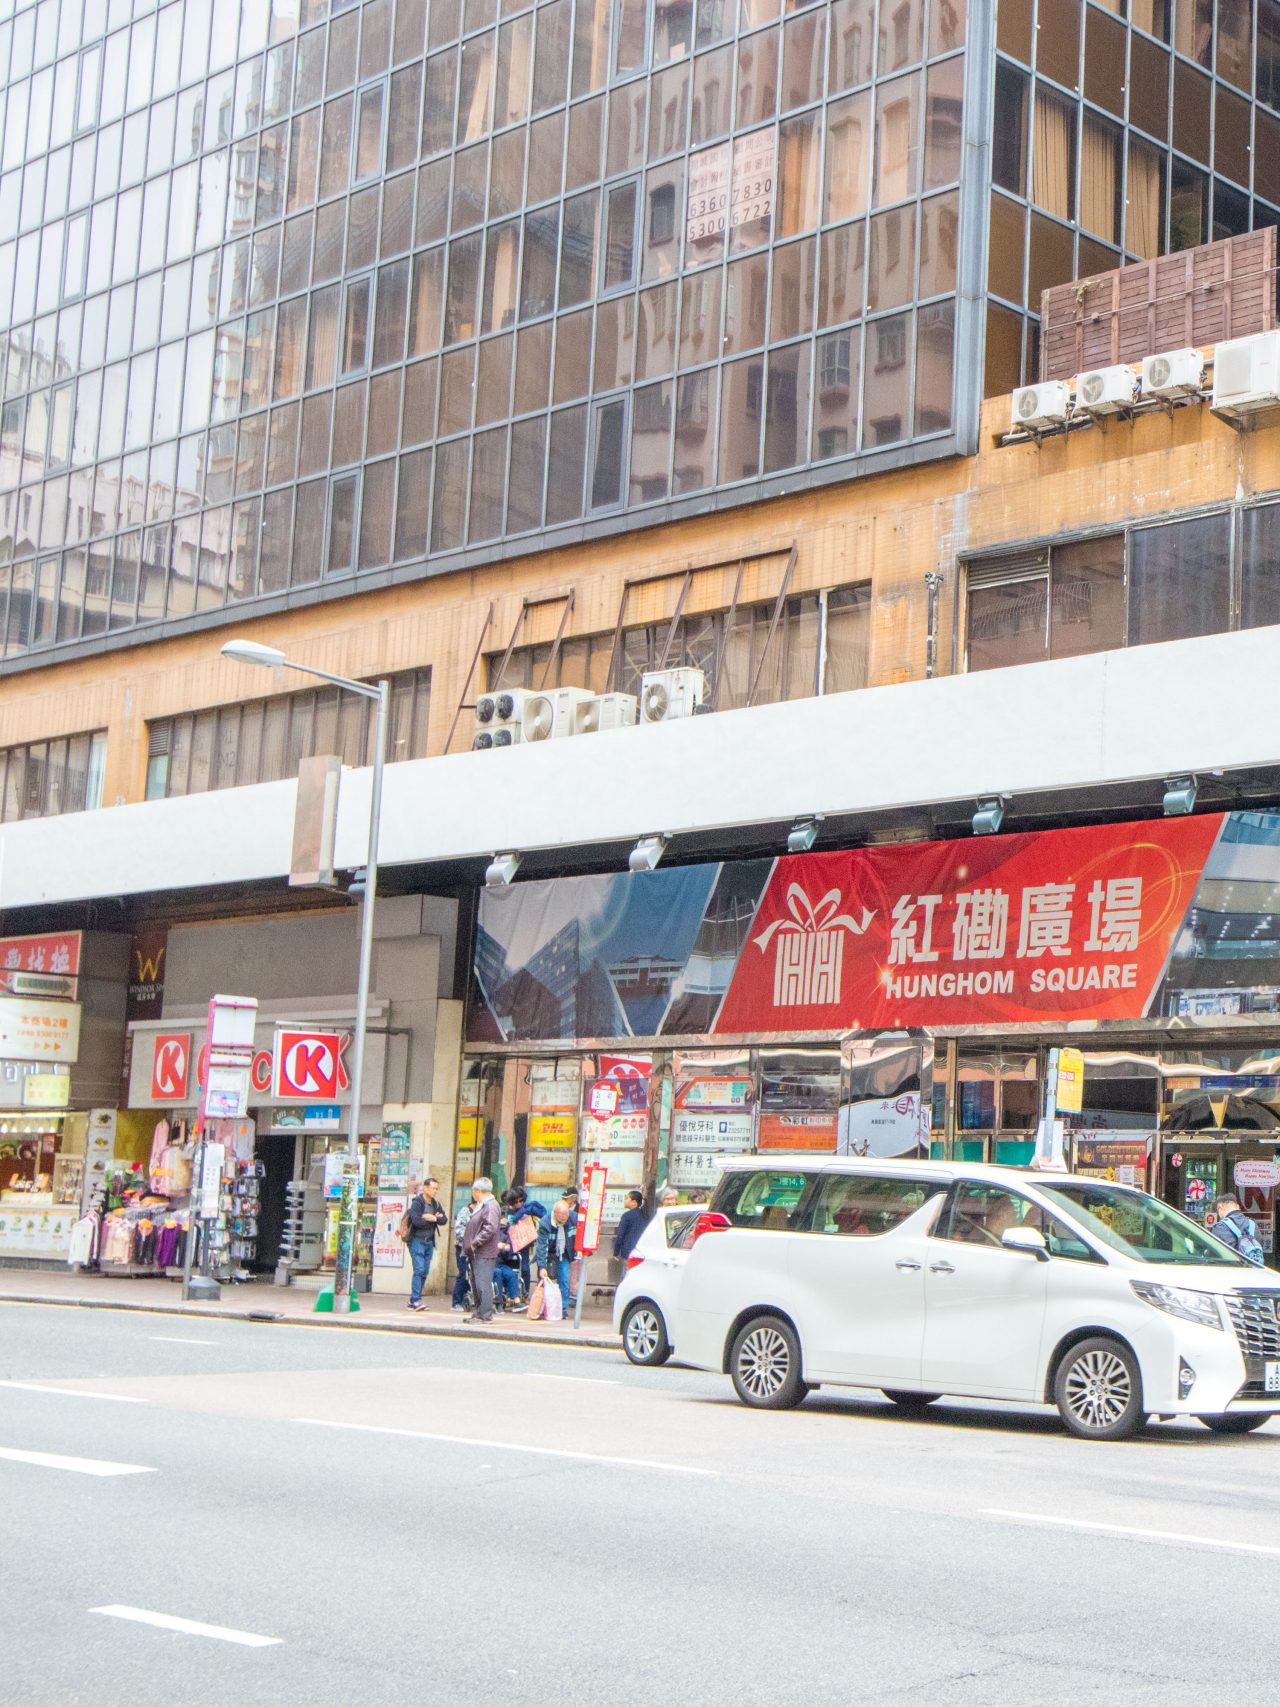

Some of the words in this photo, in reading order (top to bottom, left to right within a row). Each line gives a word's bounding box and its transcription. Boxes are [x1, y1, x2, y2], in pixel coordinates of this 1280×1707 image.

[690, 194, 727, 218] 6360
[733, 178, 772, 206] 7830
[689, 217, 725, 240] 5300
[732, 201, 771, 226] 6722
[887, 877, 1143, 965] 紅磡廣場
[885, 970, 1015, 1000] HUNGHOM
[1029, 963, 1139, 993] SQUARE
[161, 1044, 184, 1092] K
[294, 1044, 331, 1093] K
